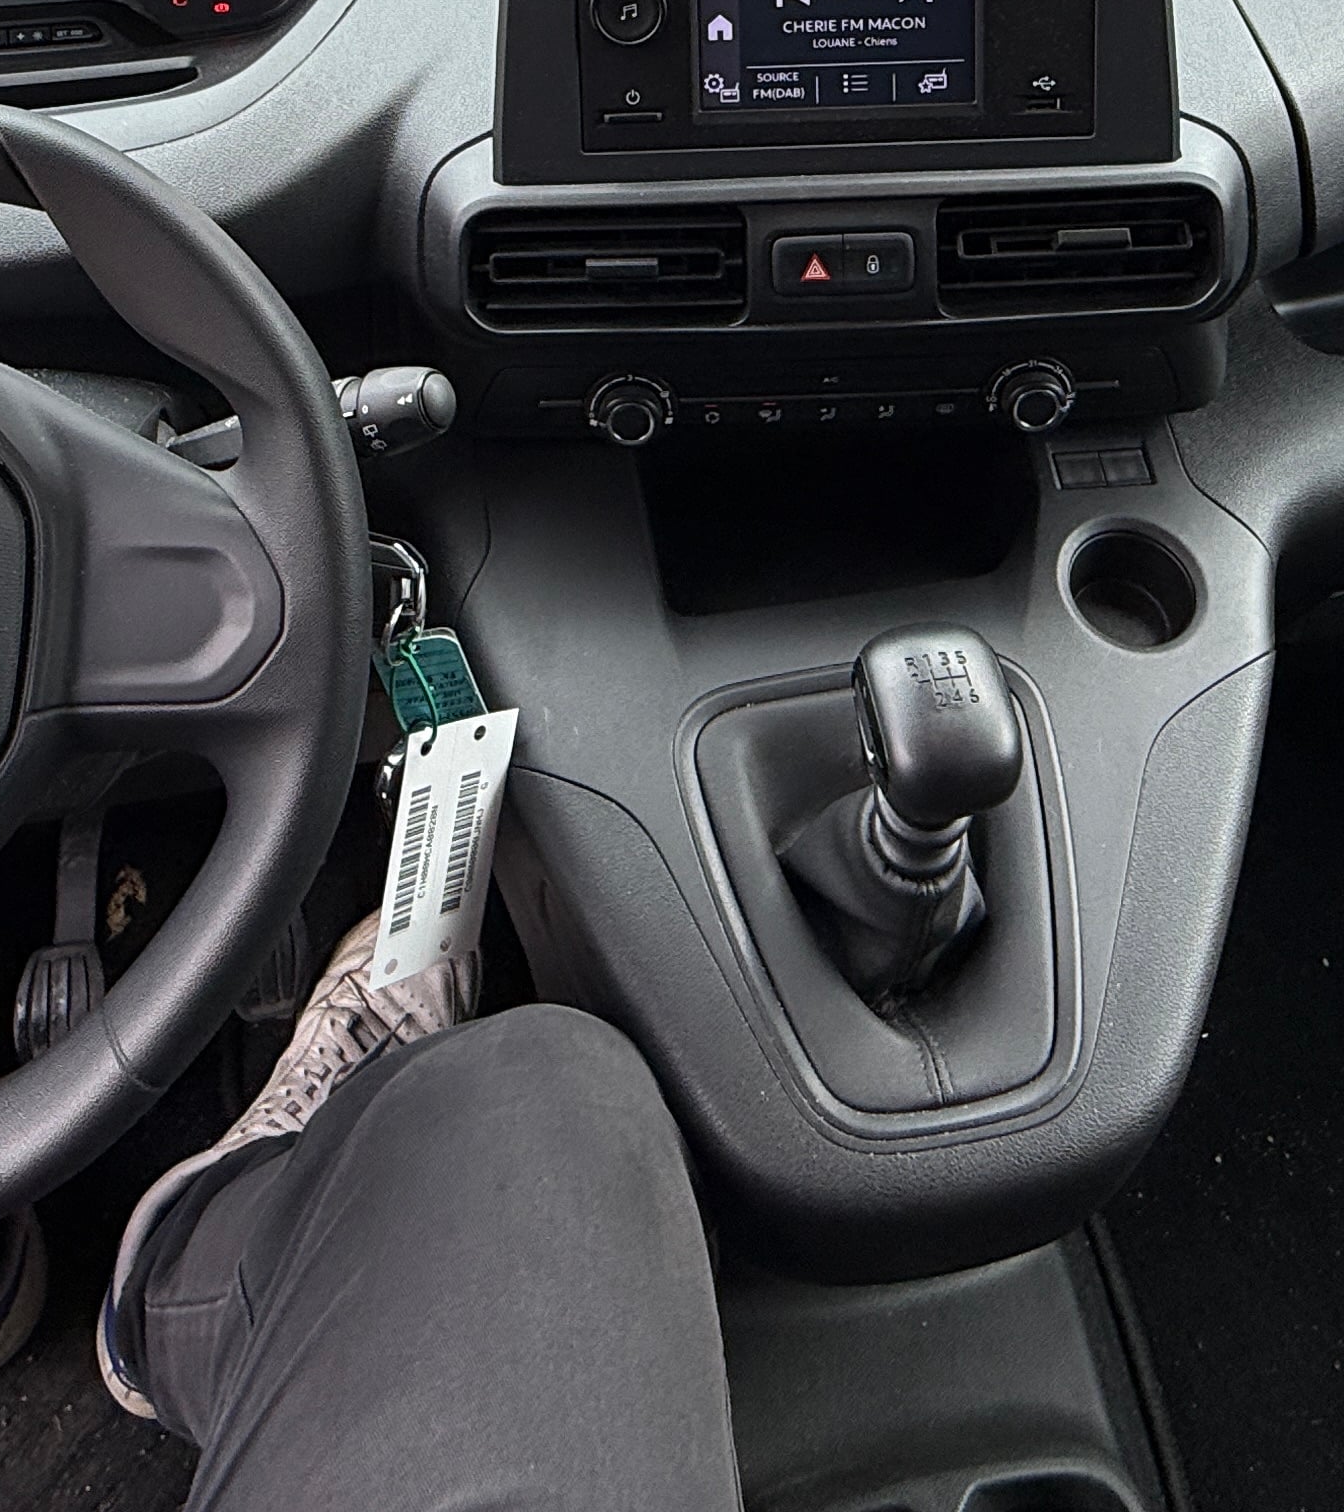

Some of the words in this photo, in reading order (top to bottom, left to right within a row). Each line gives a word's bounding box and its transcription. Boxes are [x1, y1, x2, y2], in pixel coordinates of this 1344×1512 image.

[782, 19, 837, 34] CHERIE
[841, 19, 865, 32] FM
[868, 16, 927, 31] MACON
[812, 38, 856, 50] LOUANE
[863, 36, 898, 47] Chiens
[756, 72, 800, 83] SOURCE
[752, 86, 806, 101] FM(DAB)
[904, 657, 918, 672] R
[922, 653, 931, 666] 1
[938, 651, 950, 666] 3
[954, 650, 967, 664] 5
[935, 692, 947, 707] 2
[953, 689, 963, 701] 4
[969, 688, 980, 703] 6
